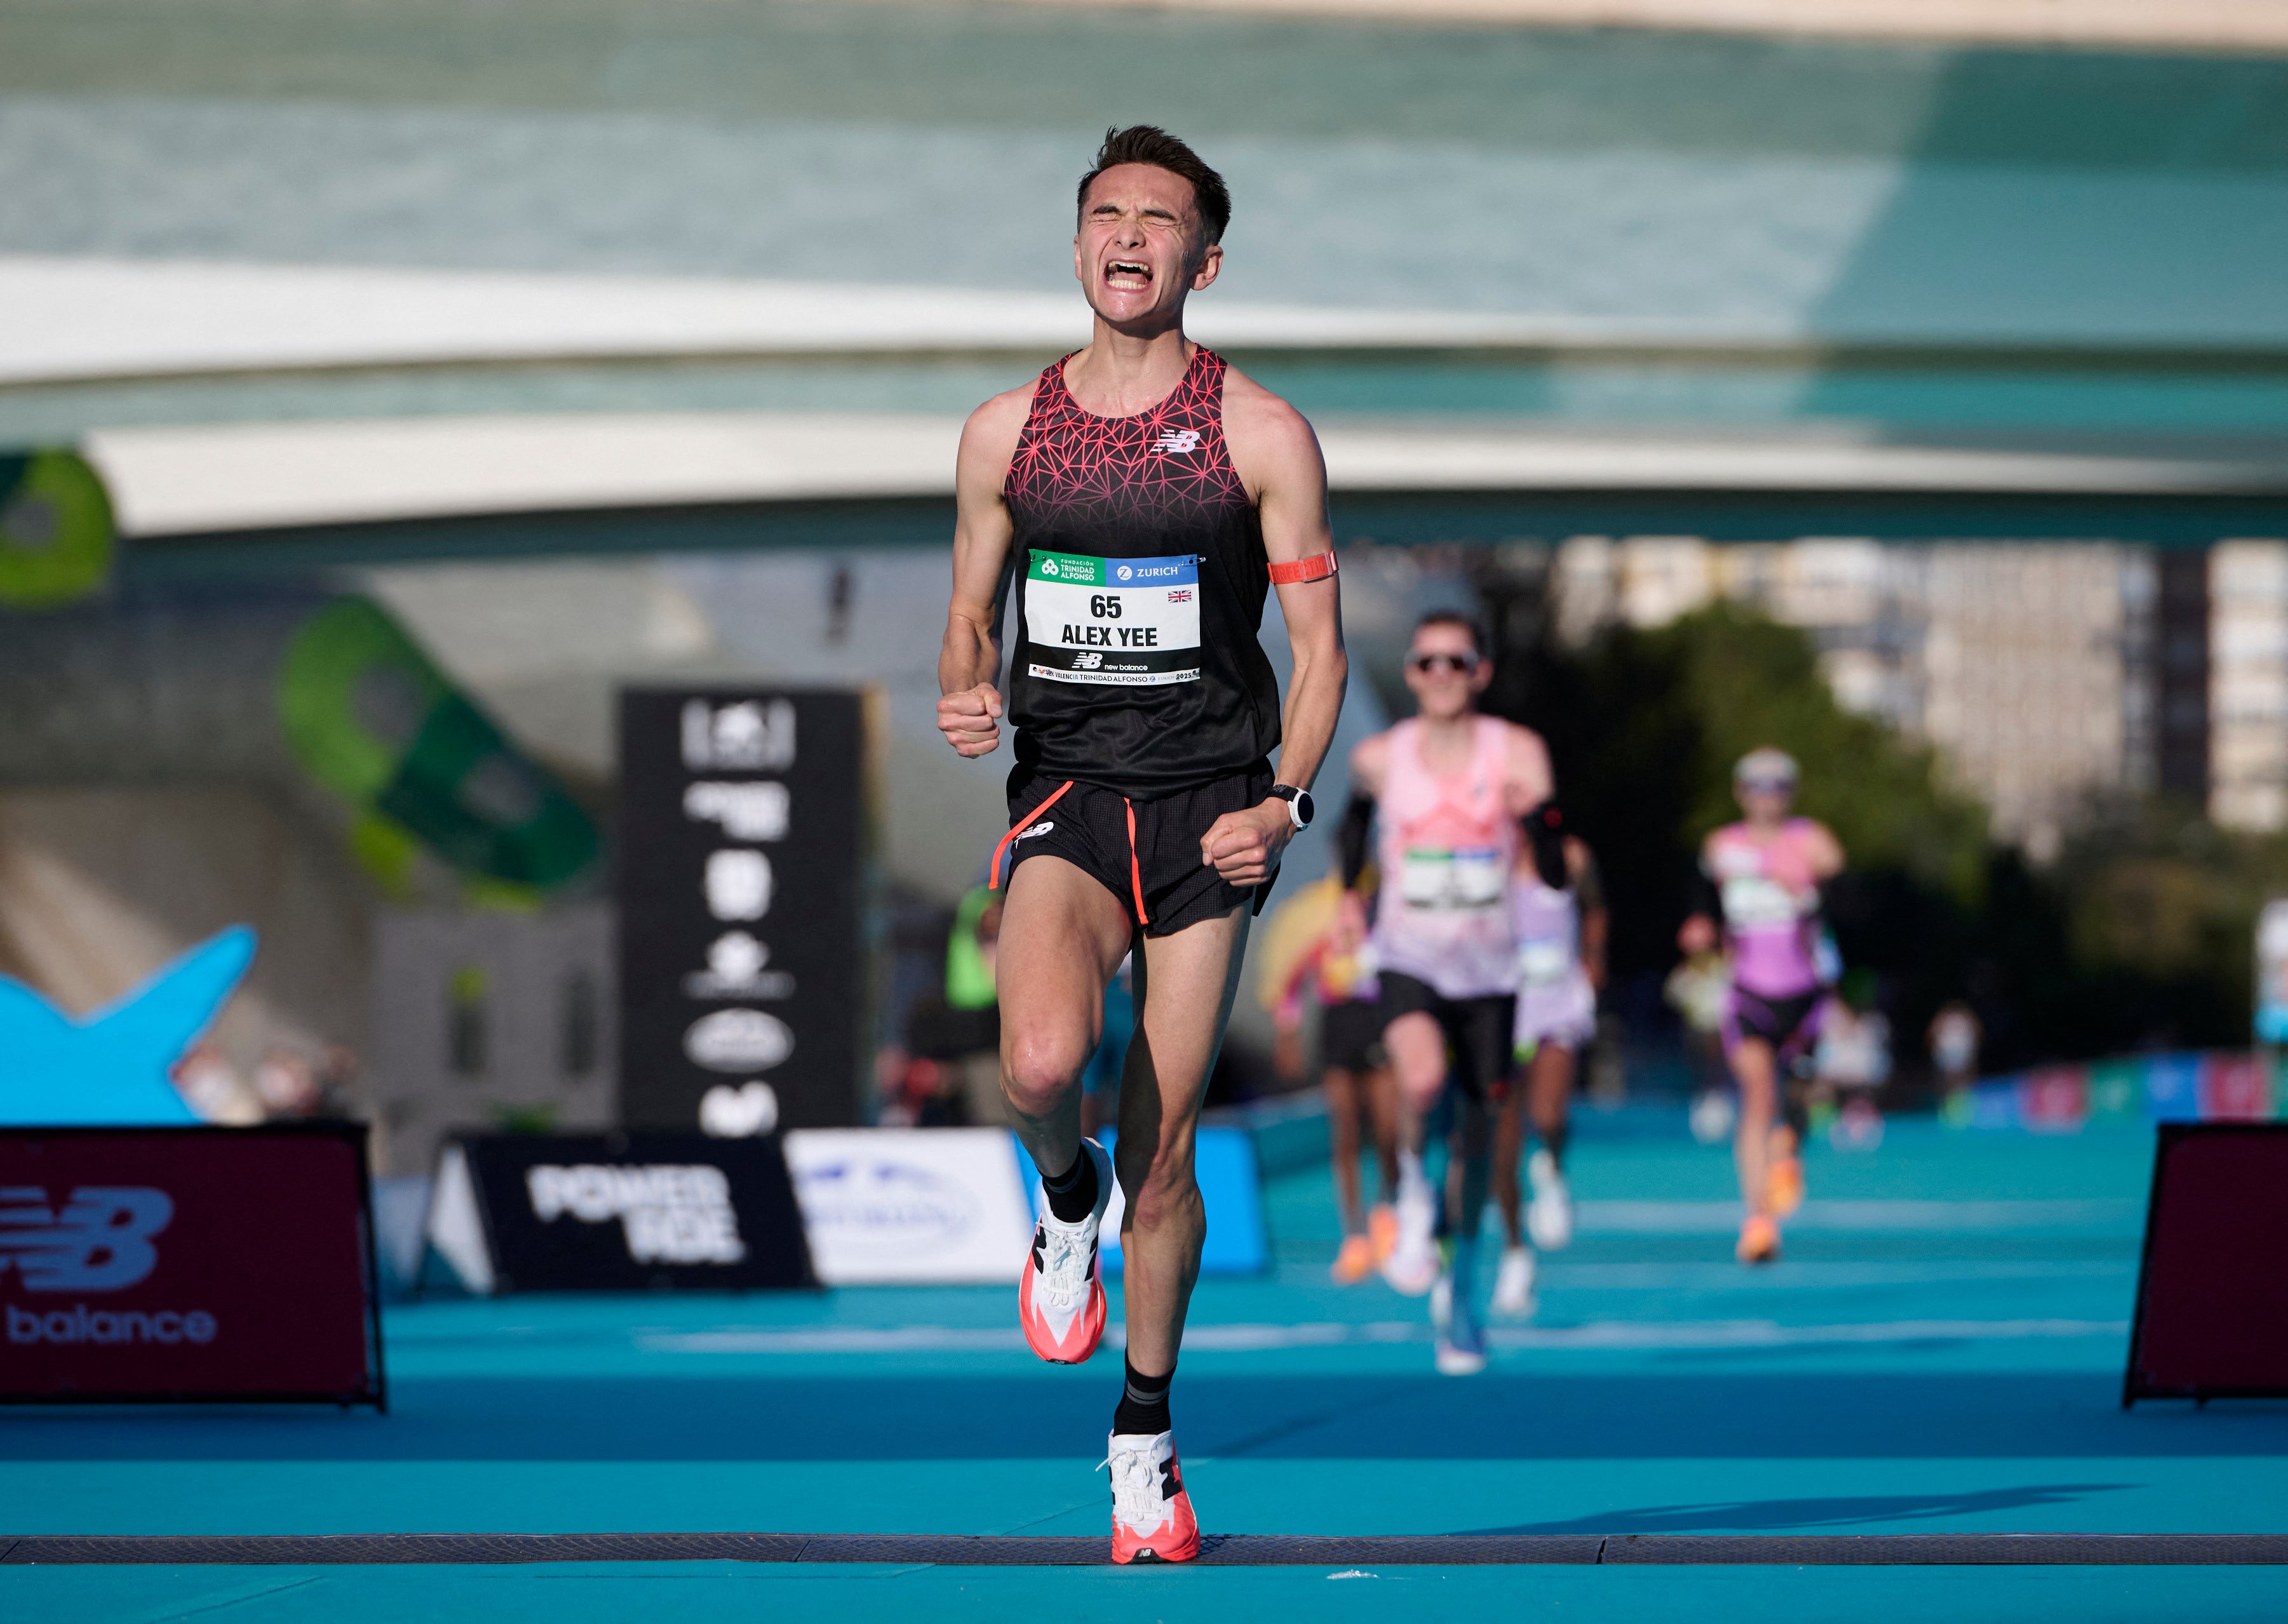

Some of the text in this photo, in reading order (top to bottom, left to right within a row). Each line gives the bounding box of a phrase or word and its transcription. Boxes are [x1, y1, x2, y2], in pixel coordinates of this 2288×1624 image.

[1061, 558, 1094, 567] FUNDACIÓN
[1060, 564, 1094, 574] TRINIDAD
[1136, 567, 1178, 577] ZURICH
[1060, 572, 1094, 581] ALFONSO
[1090, 594, 1122, 619] 65
[1061, 624, 1158, 647] ALEX YEE
[1054, 671, 1079, 680] VALENCIA
[6, 1303, 217, 1344] balance
